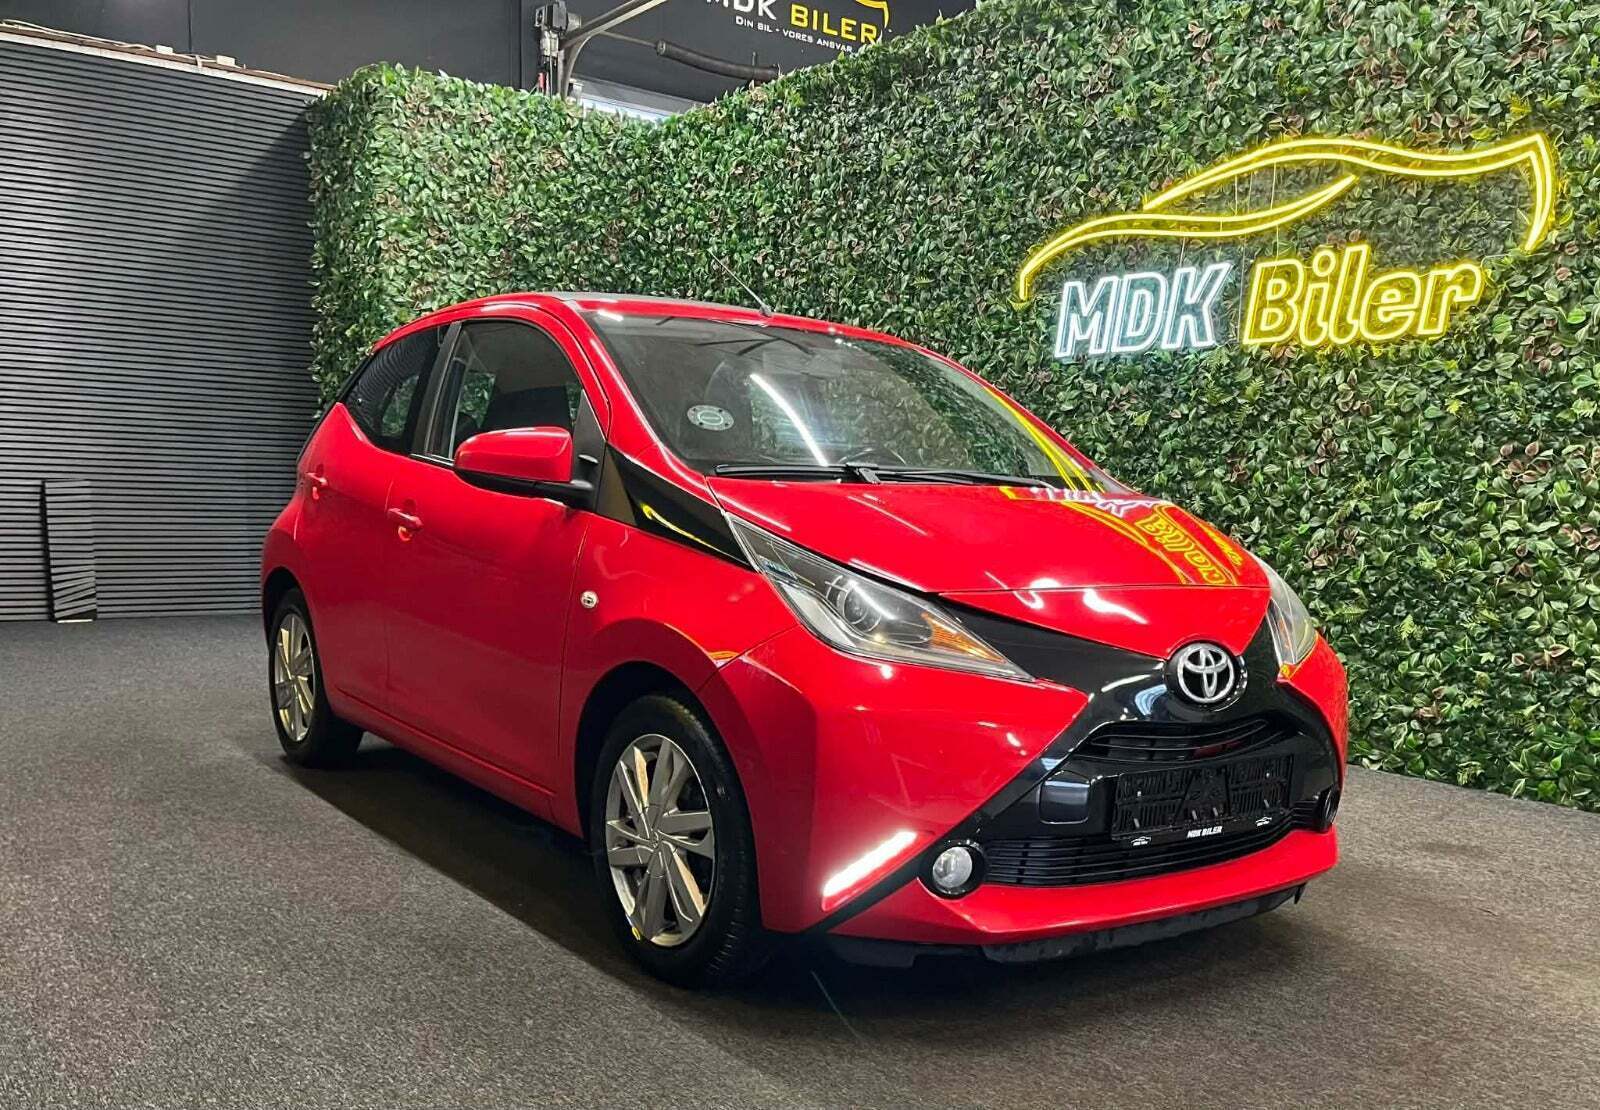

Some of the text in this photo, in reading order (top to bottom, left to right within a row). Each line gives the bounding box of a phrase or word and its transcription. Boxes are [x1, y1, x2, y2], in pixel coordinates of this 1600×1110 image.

[736, 15, 754, 28] DIN
[757, 22, 773, 33] BIL
[782, 29, 813, 43] VORES
[791, 4, 877, 46] BILER
[1055, 243, 1484, 358] MDK Biler
